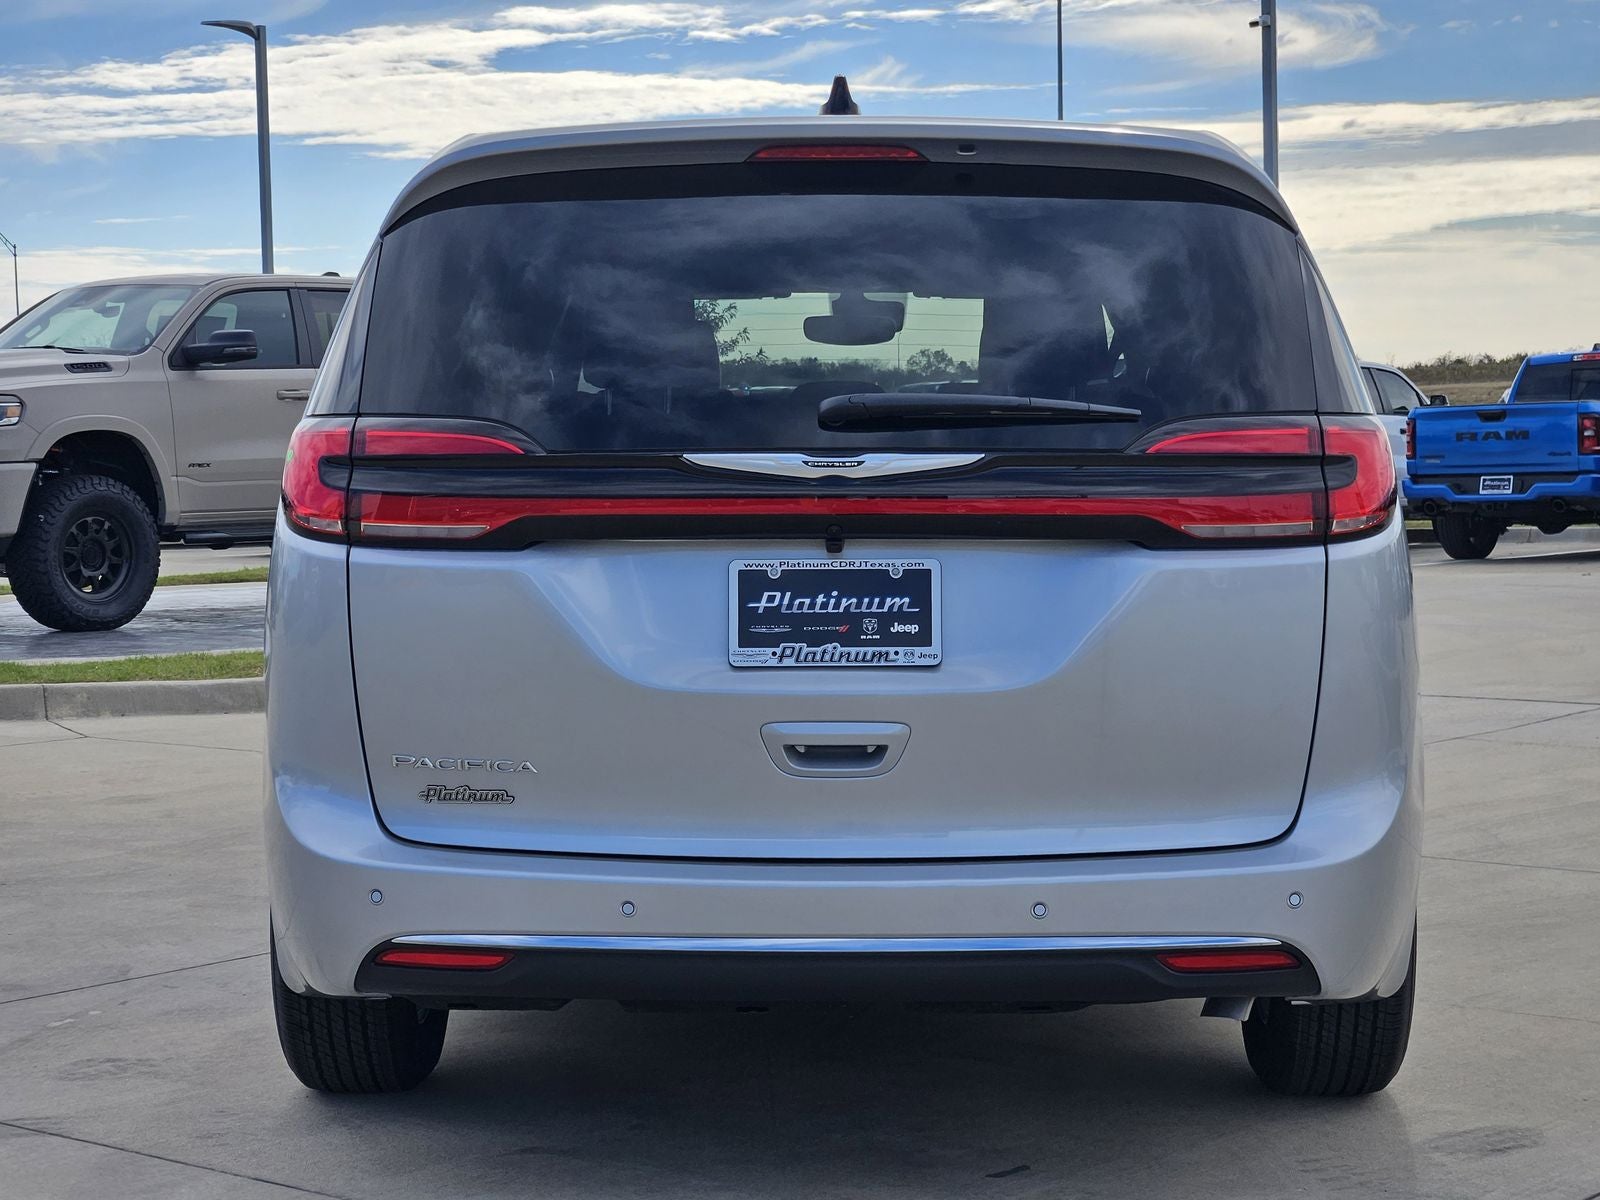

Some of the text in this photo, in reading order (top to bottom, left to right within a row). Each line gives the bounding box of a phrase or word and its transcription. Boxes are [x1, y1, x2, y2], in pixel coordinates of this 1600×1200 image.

[1456, 430, 1530, 442] RAM
[743, 560, 925, 569] www.PlatinumCDRJTexas.com
[747, 590, 920, 613] Platinum
[890, 622, 919, 634] Jeep
[778, 644, 900, 664] Platinum
[918, 652, 939, 660] Jeep
[392, 755, 538, 773] PACIFICA
[418, 785, 515, 804] Platinum
